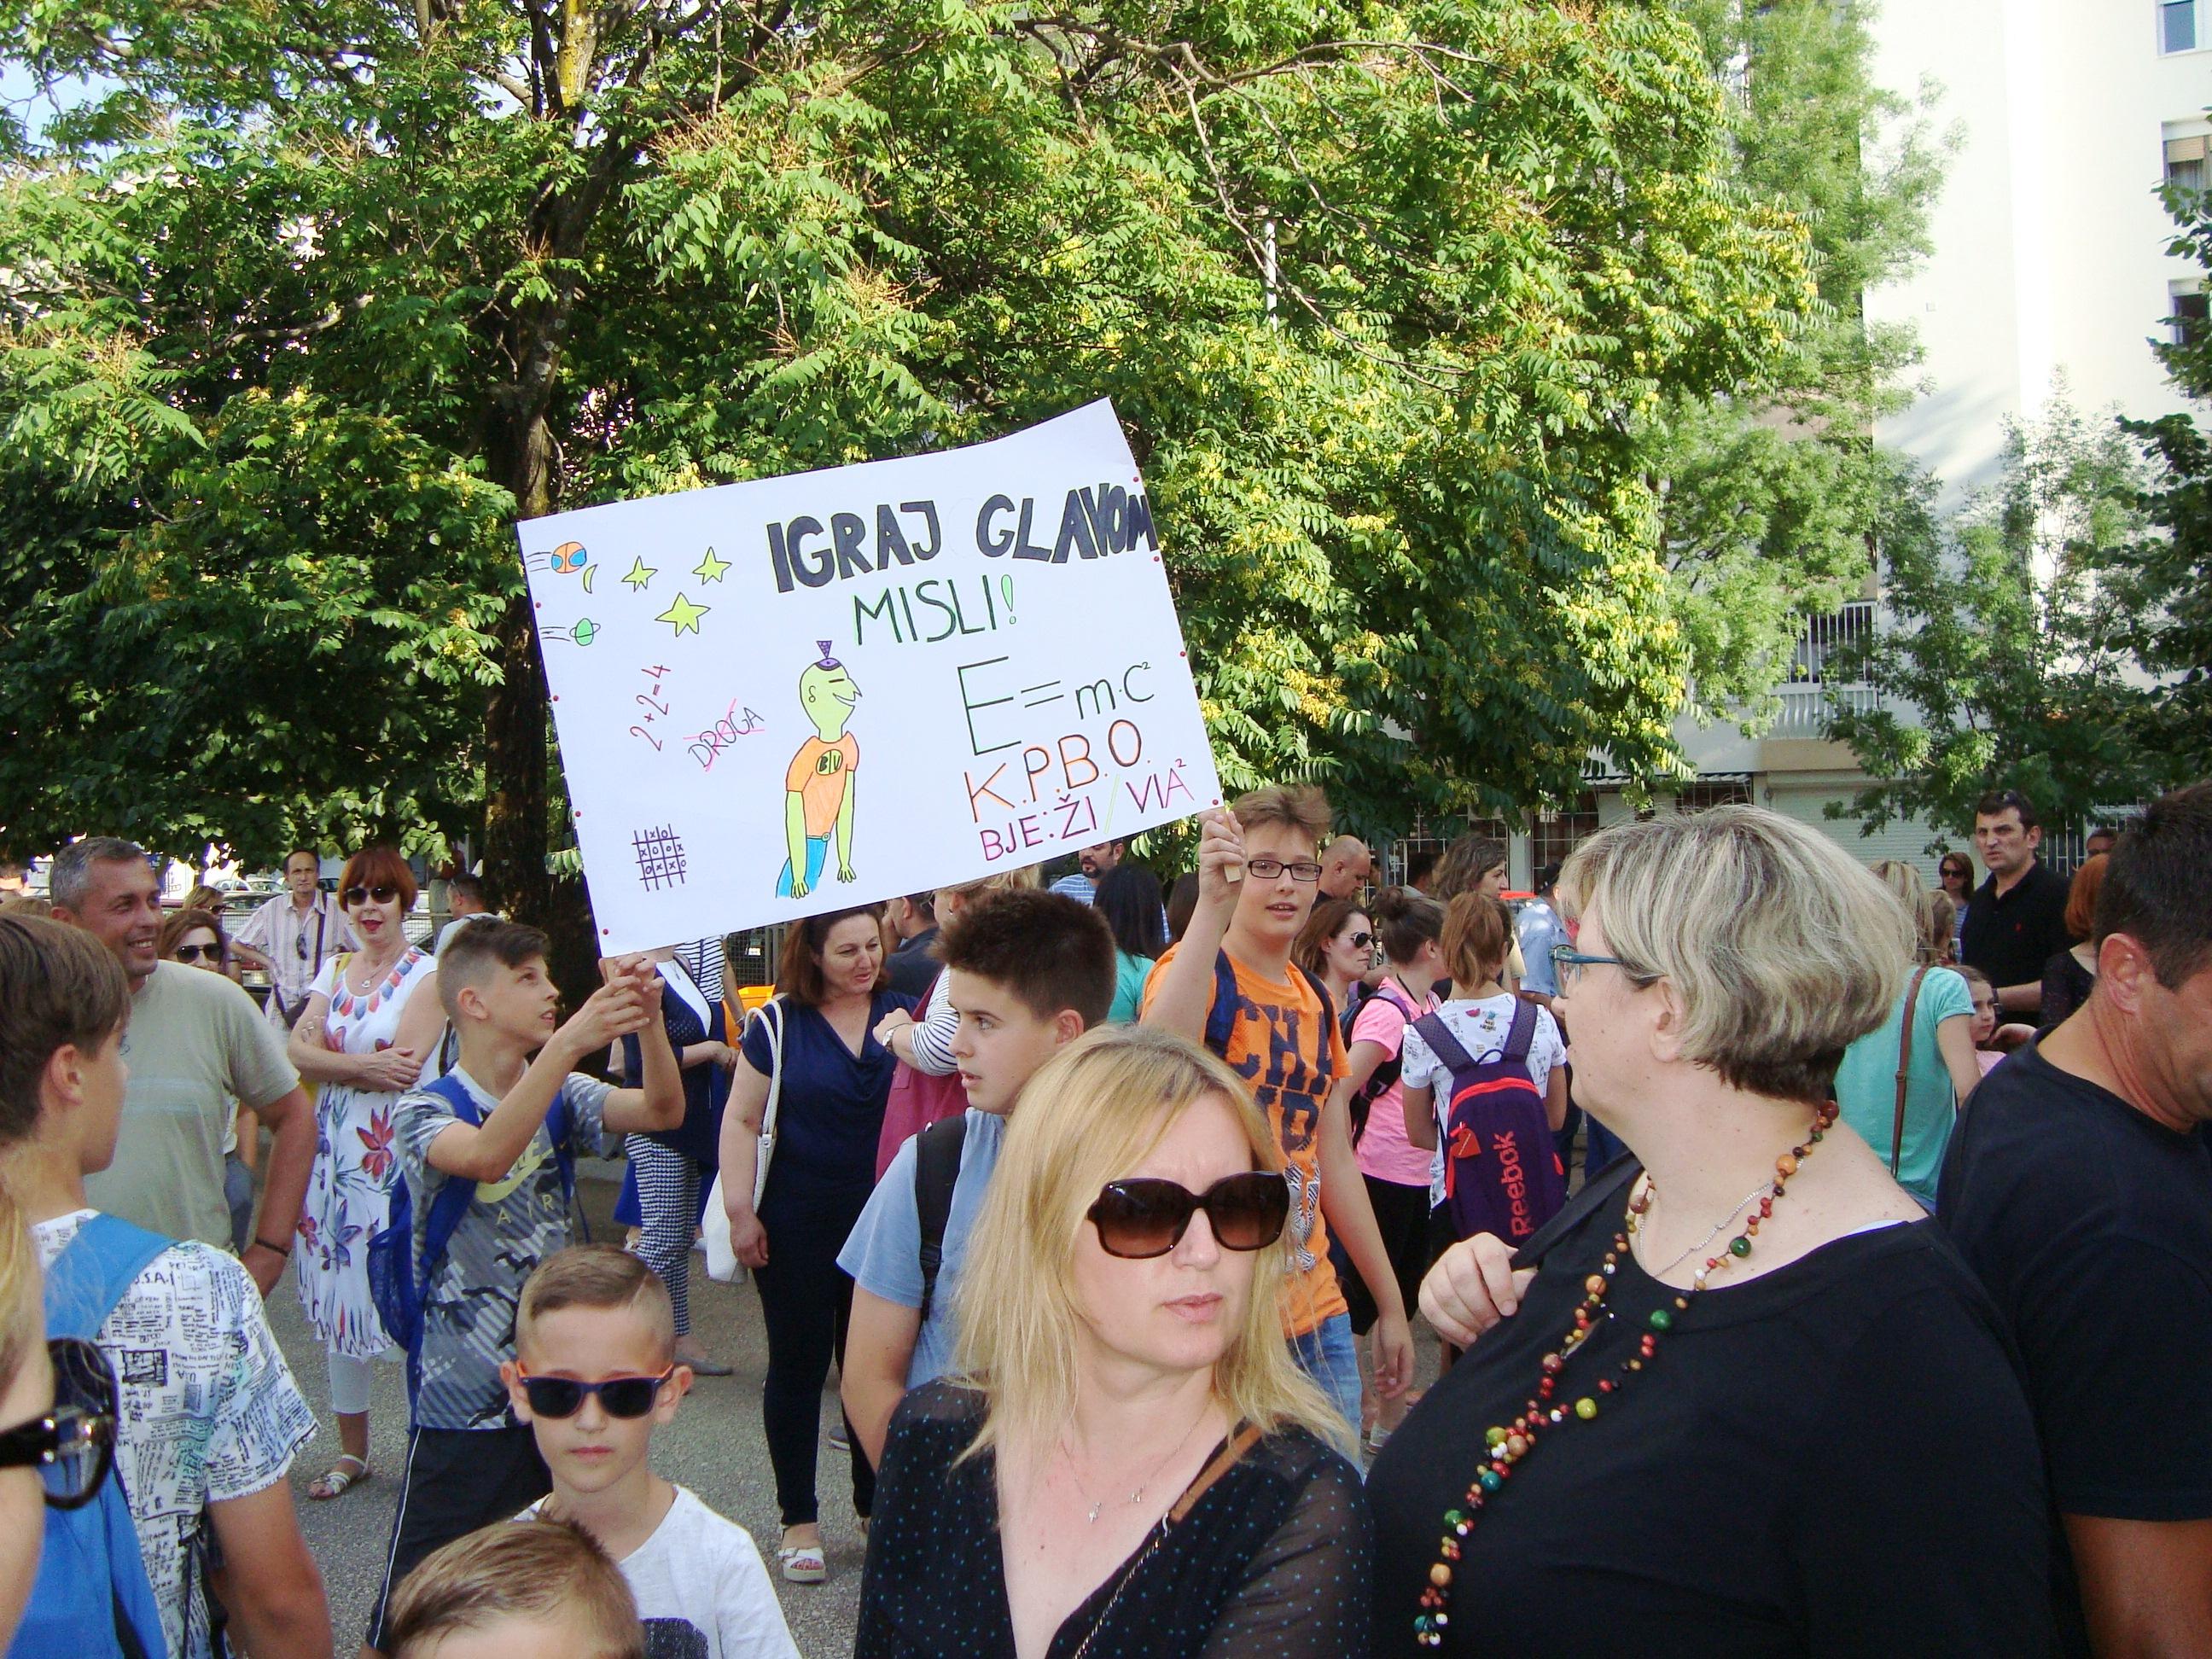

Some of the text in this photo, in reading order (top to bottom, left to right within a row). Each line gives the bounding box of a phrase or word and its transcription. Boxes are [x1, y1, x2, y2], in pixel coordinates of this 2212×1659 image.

[767, 483, 1159, 593] IGRAJ GLAVOM
[853, 573, 1017, 645] MISLI!
[688, 707, 765, 768] DROGA
[497, 1194, 554, 1225] AIR
[1493, 1130, 1534, 1237] Reebok
